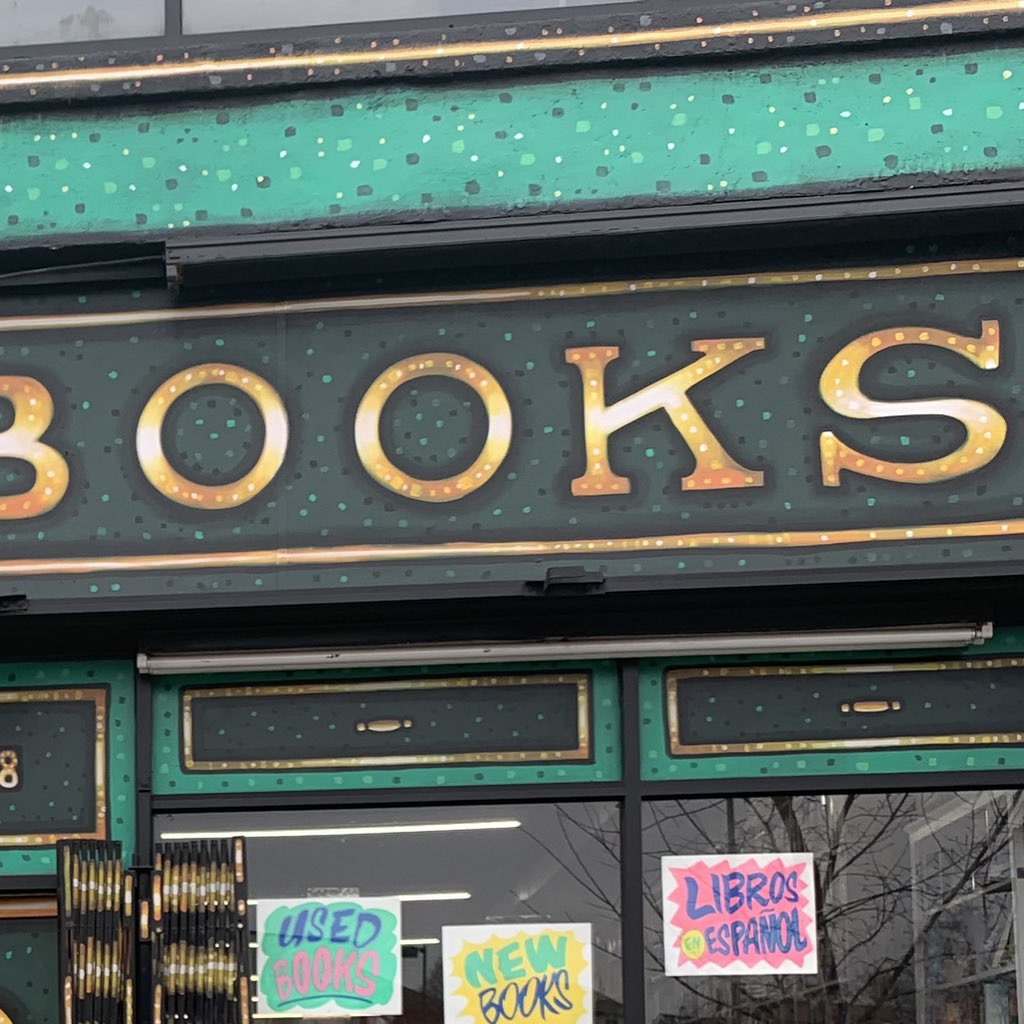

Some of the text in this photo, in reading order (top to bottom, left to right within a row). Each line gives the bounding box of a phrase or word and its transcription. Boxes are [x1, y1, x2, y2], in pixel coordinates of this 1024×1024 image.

[684, 871, 799, 920] LIBROS
[279, 908, 382, 949] USED
[684, 907, 808, 957] EN ESPAÑOL
[273, 947, 380, 1001] BOOKS
[464, 934, 569, 989] NEW
